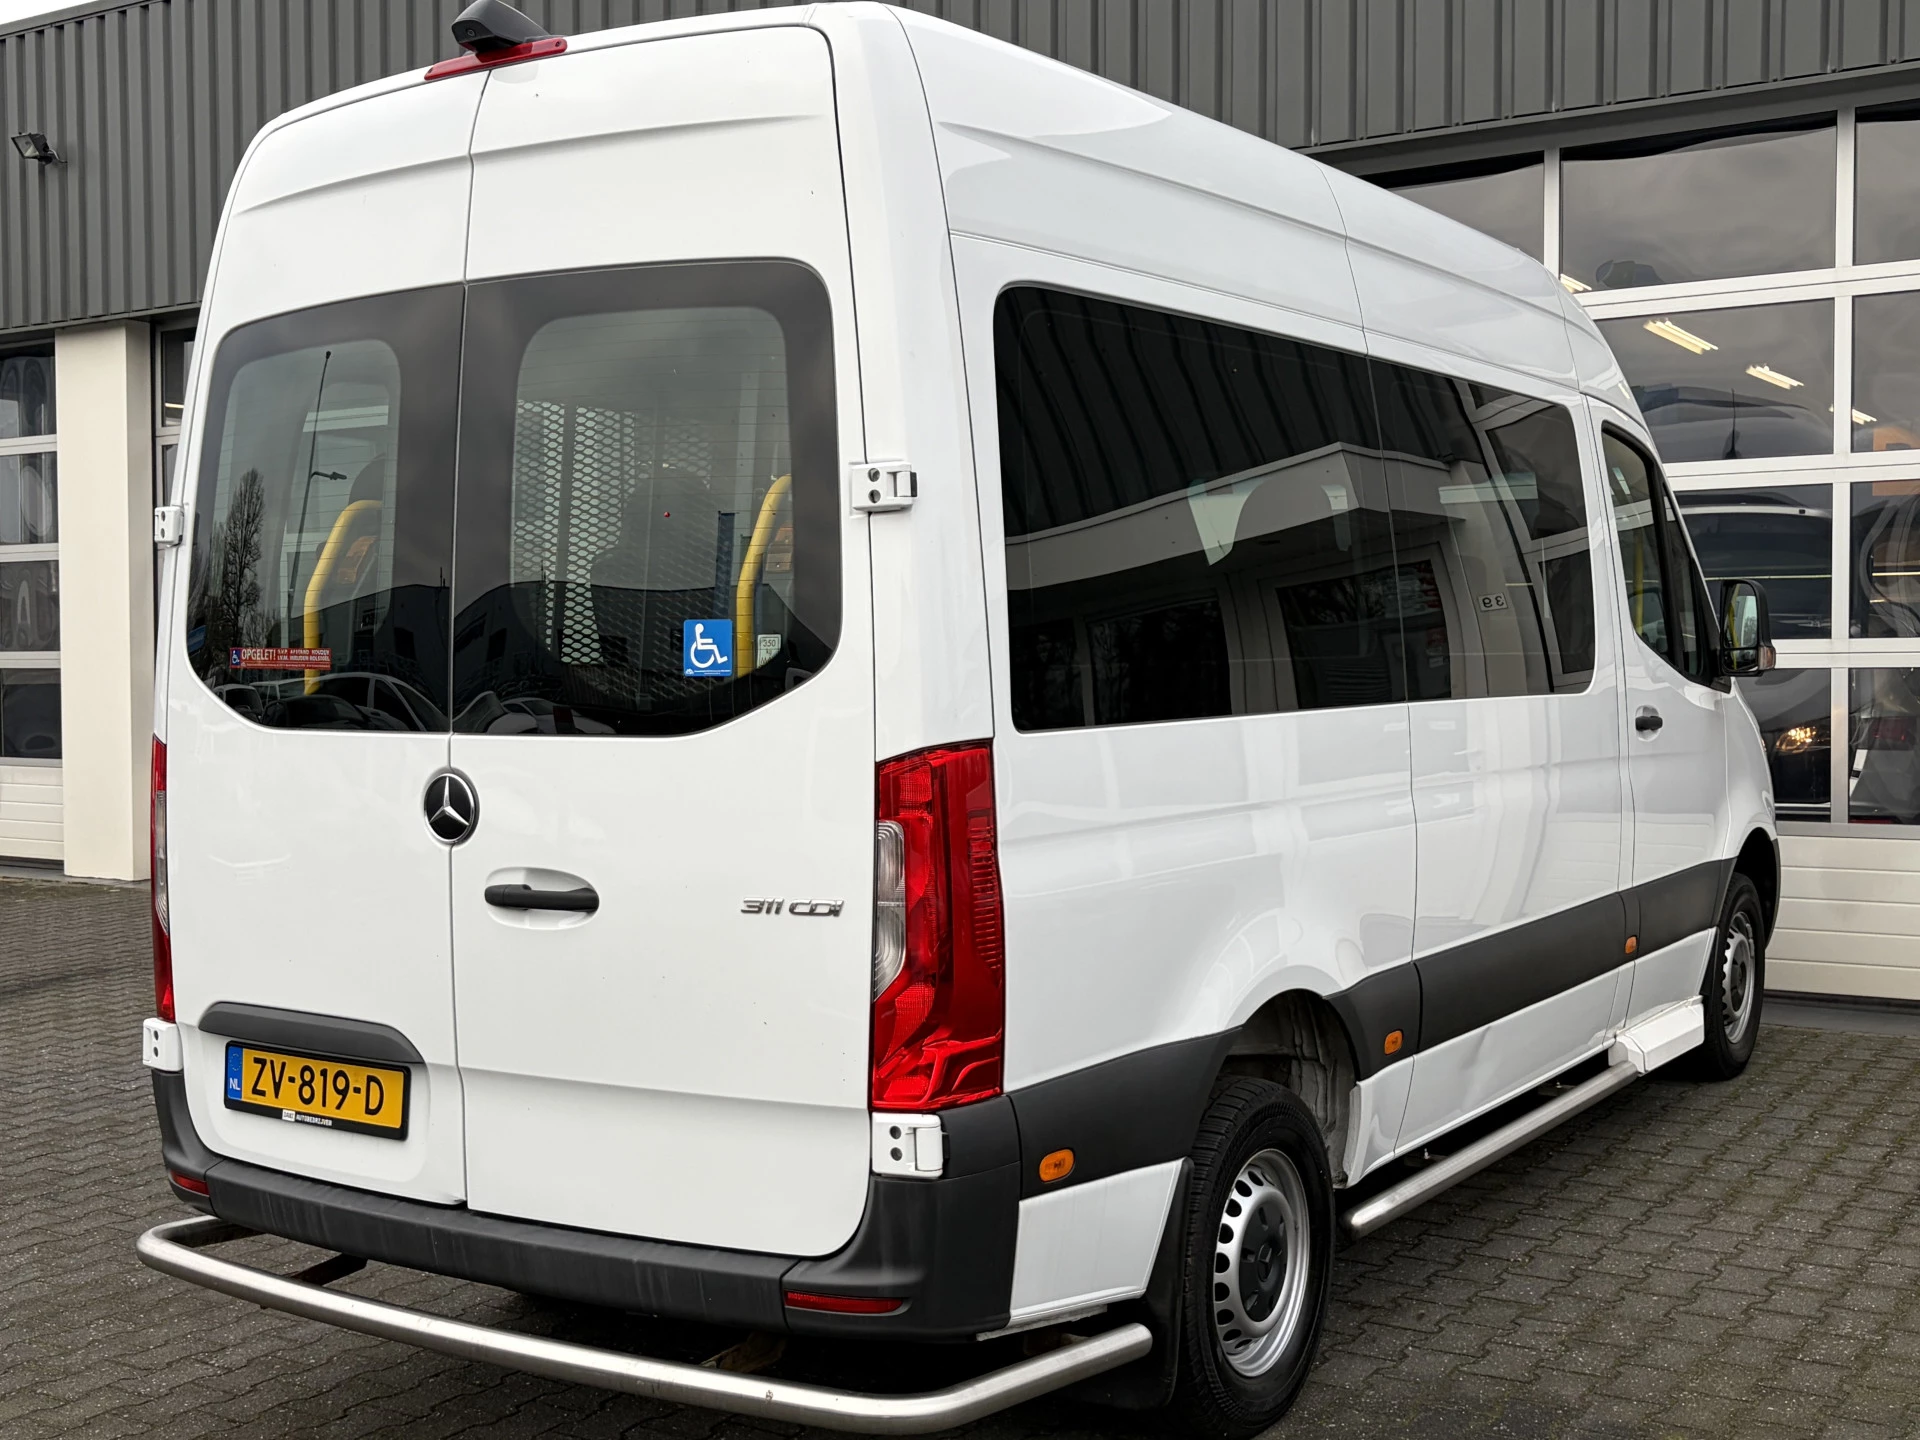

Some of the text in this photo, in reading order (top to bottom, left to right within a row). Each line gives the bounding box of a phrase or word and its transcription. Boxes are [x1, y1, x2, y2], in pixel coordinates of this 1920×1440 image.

[762, 639, 777, 648] 350
[241, 648, 276, 661] OPGELET!
[740, 897, 785, 915] 311
[229, 1077, 241, 1091] NL
[251, 1056, 385, 1116] ZV-819-D
